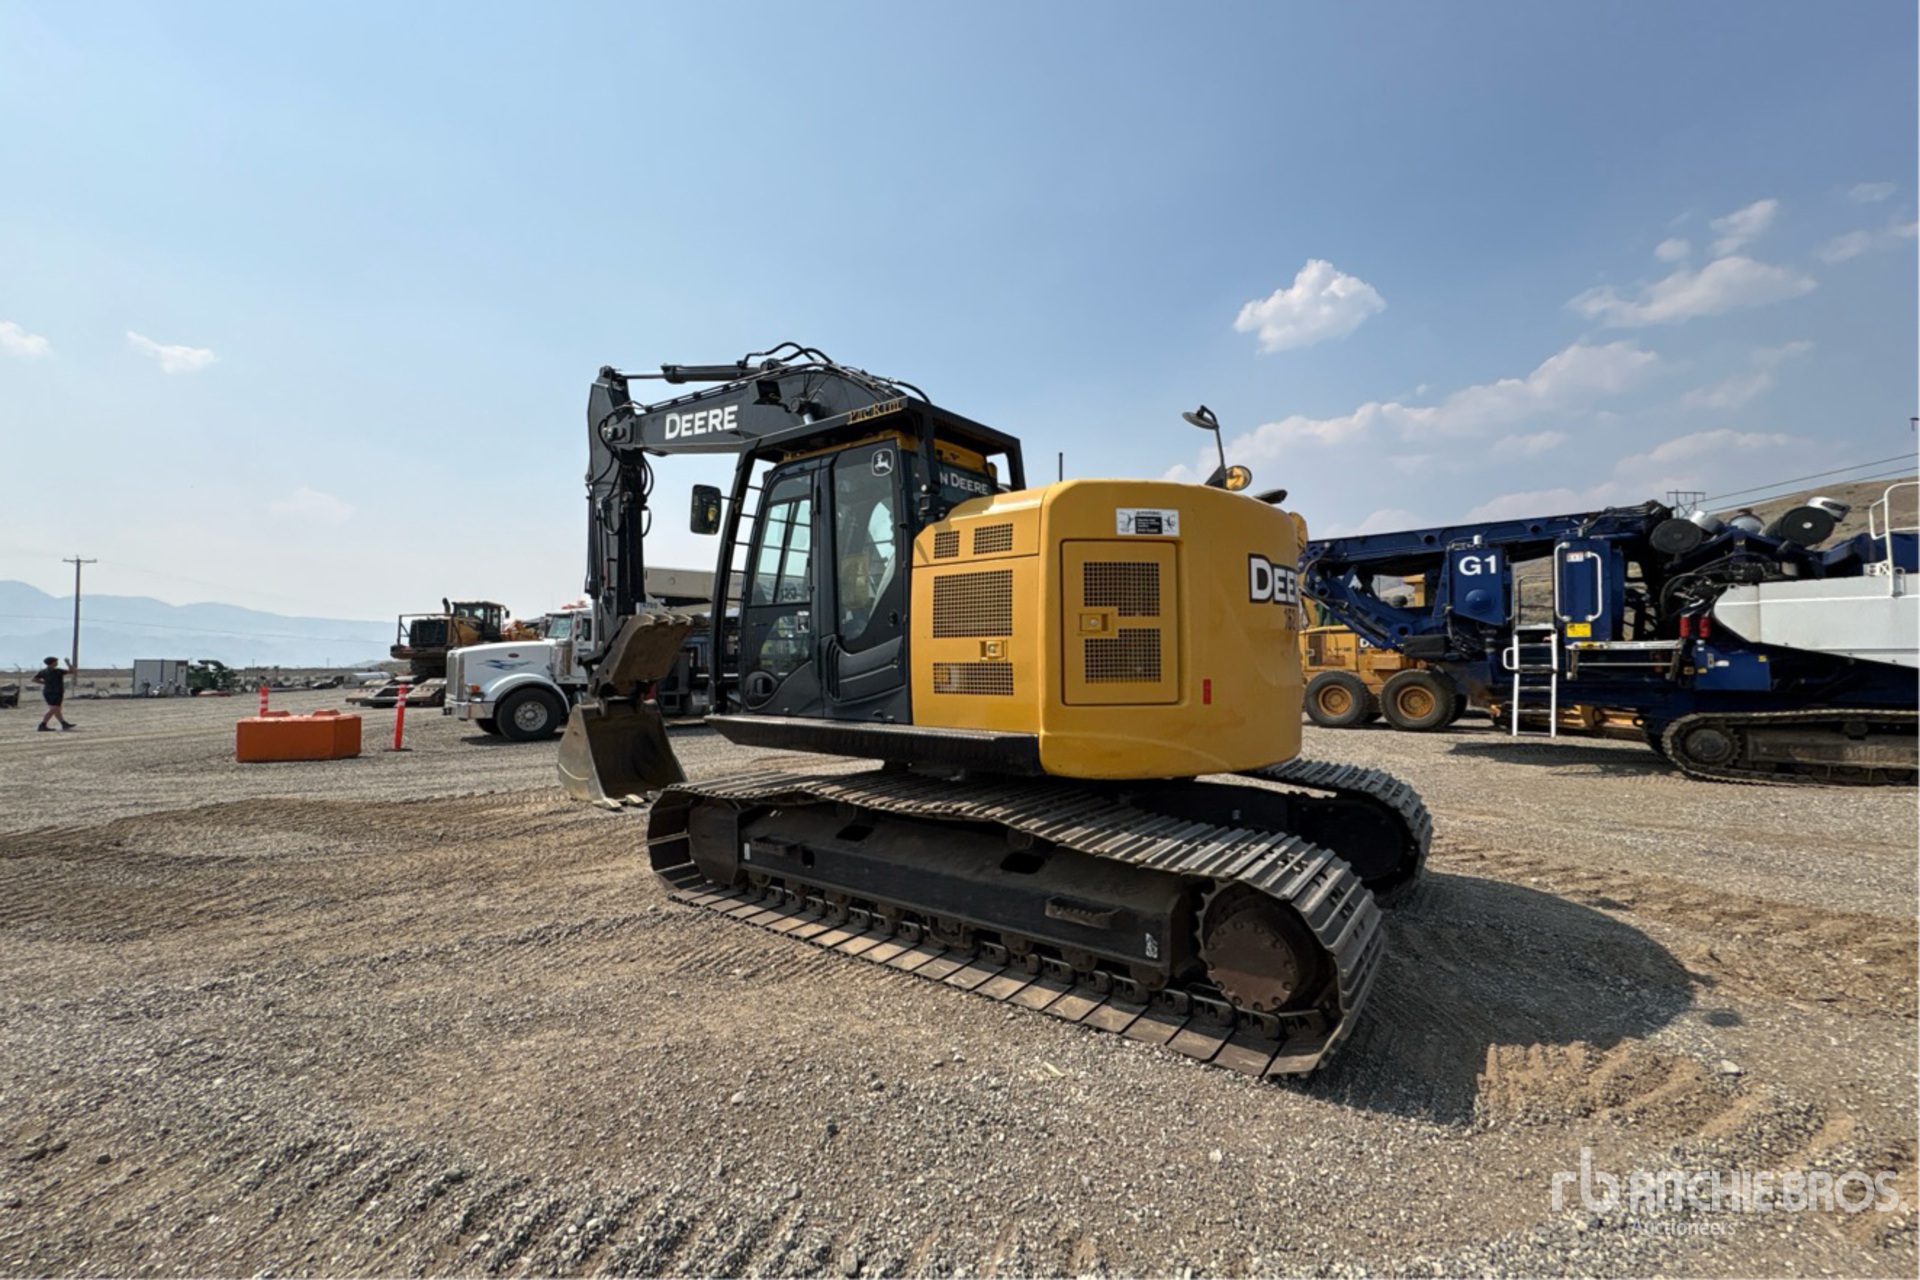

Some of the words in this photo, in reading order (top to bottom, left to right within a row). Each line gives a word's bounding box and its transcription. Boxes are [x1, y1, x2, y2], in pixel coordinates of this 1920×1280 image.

[665, 405, 738, 440] DEERE
[950, 472, 988, 495] DEERE
[1250, 556, 1298, 604] DEE
[1459, 555, 1496, 576] G1
